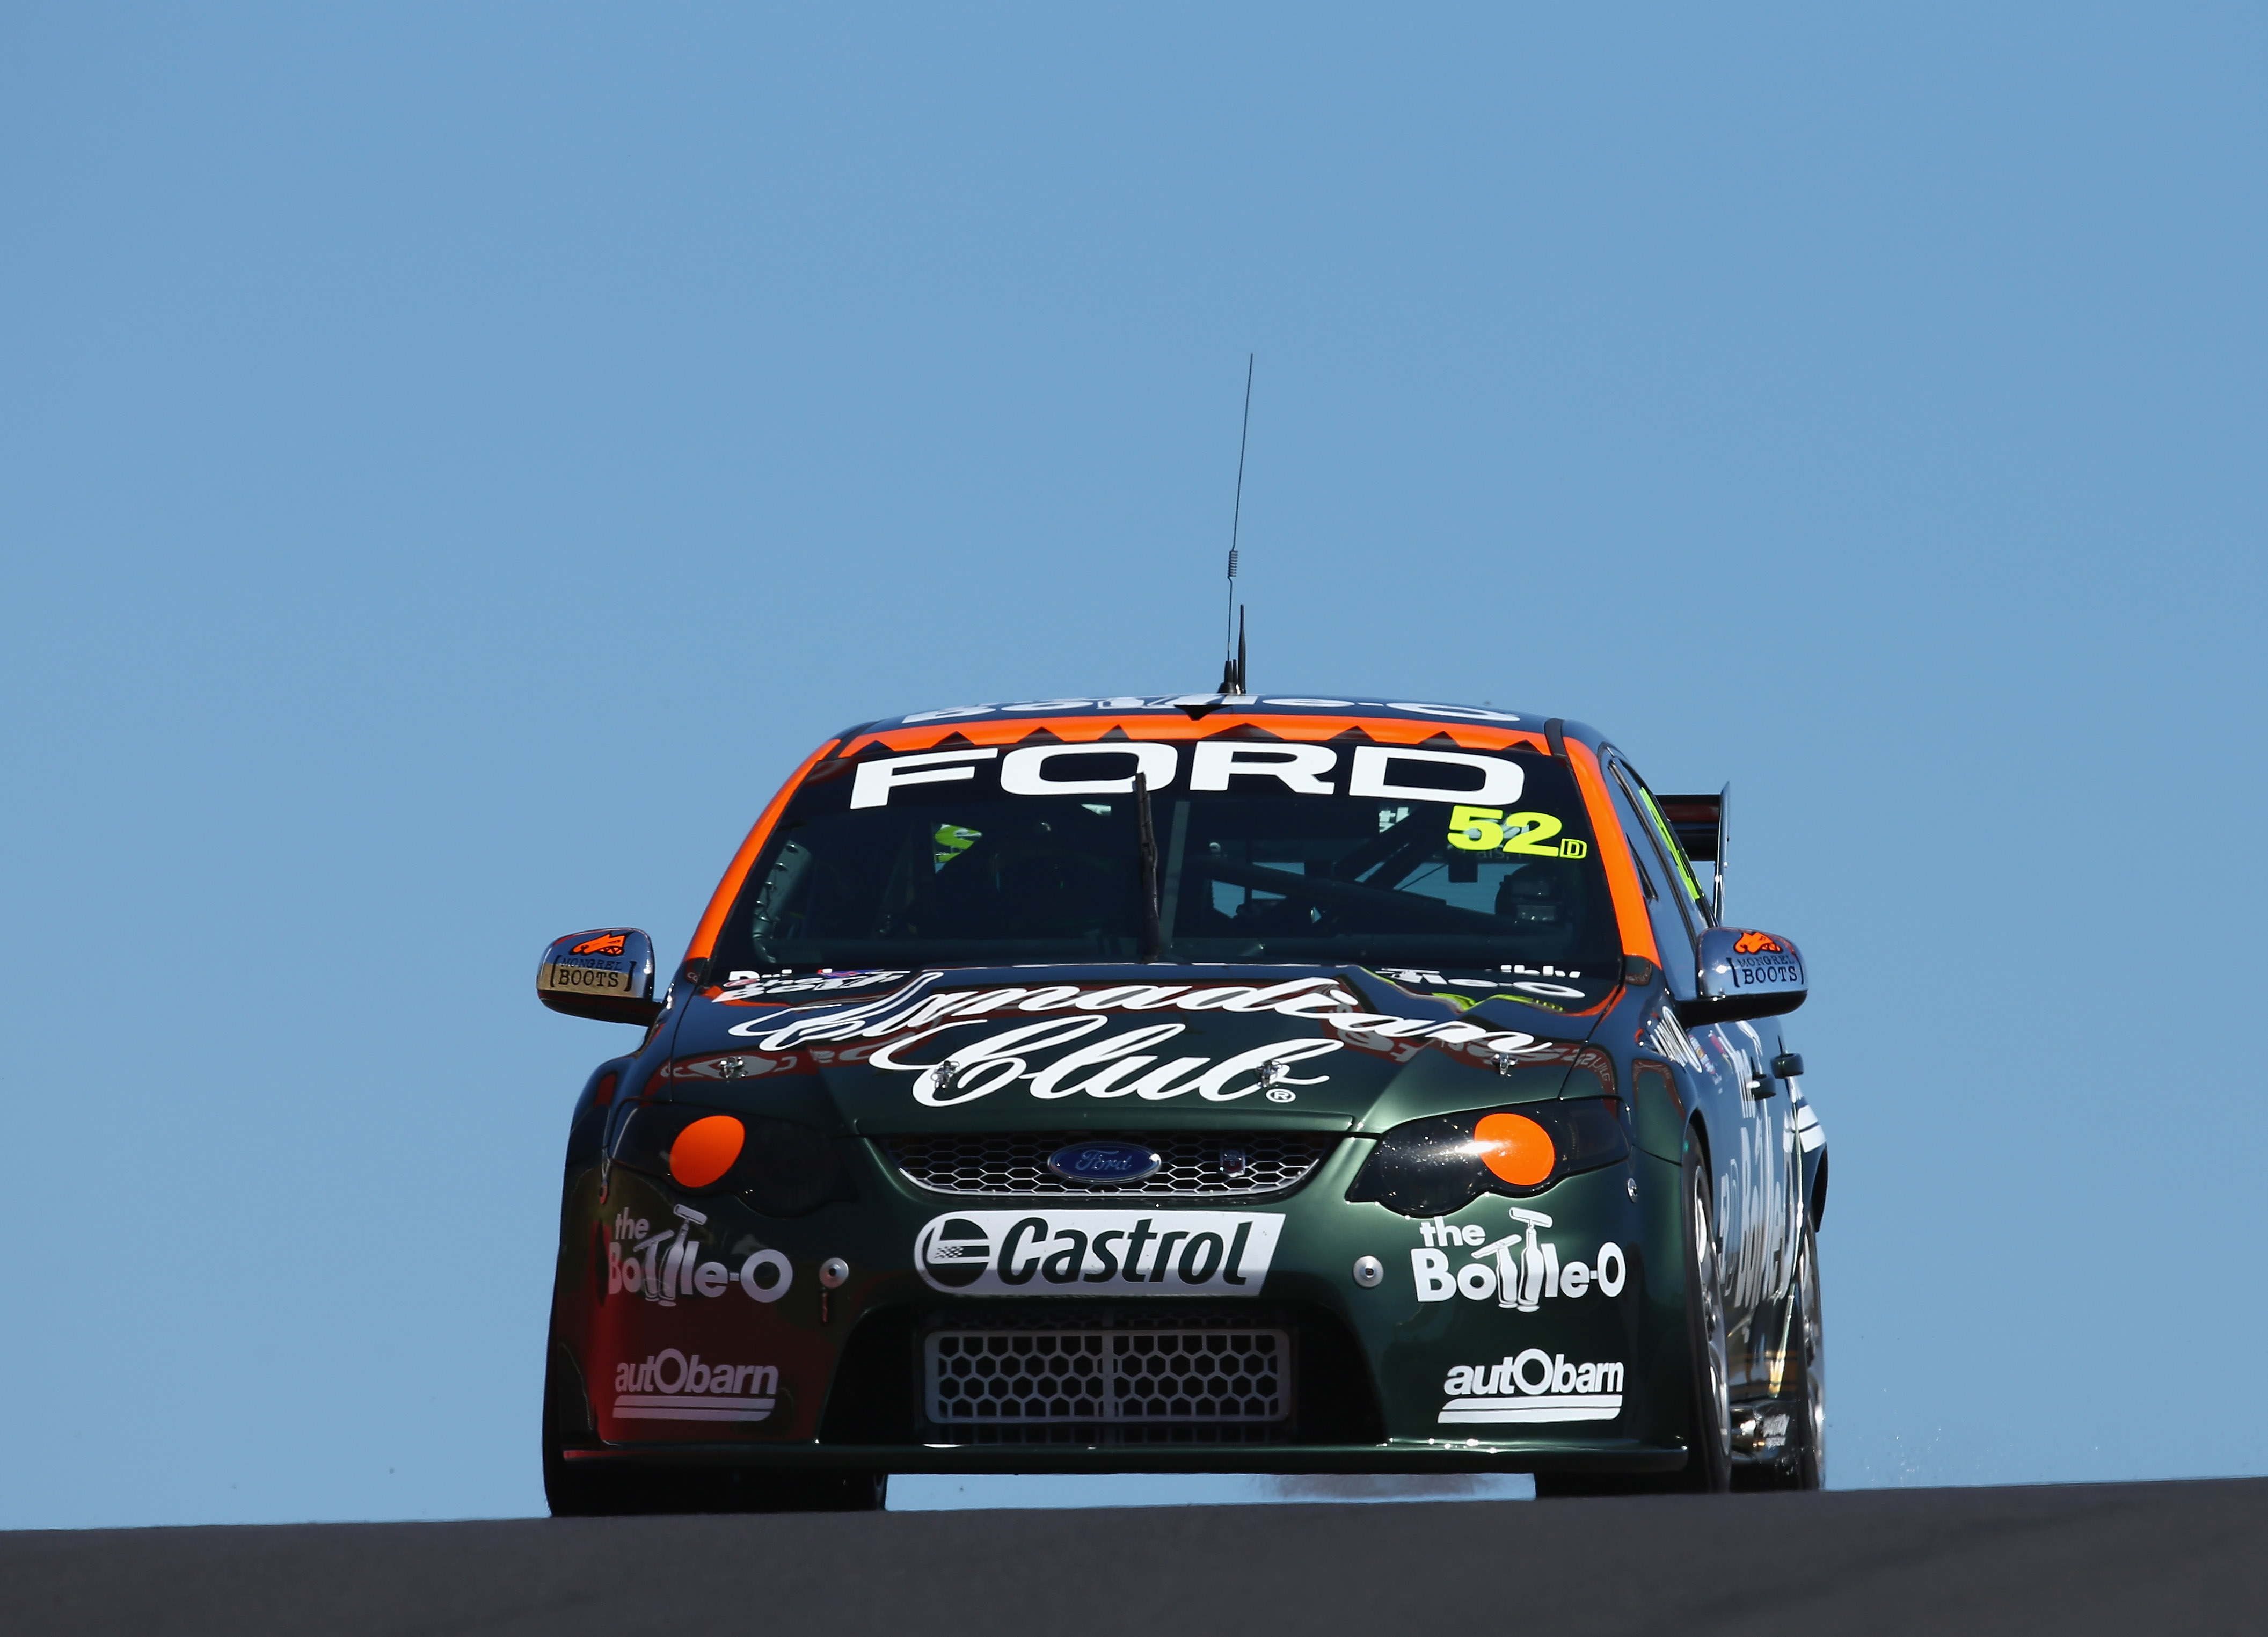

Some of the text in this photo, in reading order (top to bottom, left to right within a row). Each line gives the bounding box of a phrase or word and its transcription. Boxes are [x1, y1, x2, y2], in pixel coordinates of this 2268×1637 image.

[850, 740, 1525, 810] FORD
[1447, 805, 1562, 857] 52
[558, 969, 619, 987] BOOTS
[561, 957, 623, 971] MONGREL
[1737, 955, 1795, 967] MONGREL
[1742, 966, 1798, 984] BOOTS
[869, 1014, 1345, 1107] Club
[1075, 1149, 1132, 1172] Ford
[615, 1207, 650, 1240] the
[1419, 1216, 1486, 1247] the
[609, 1204, 793, 1307] Bottle-O
[997, 1217, 1253, 1286] Castrol
[1411, 1207, 1626, 1313] Bottle-O
[615, 1348, 779, 1395] autObarn
[1443, 1348, 1624, 1395] autObarn
